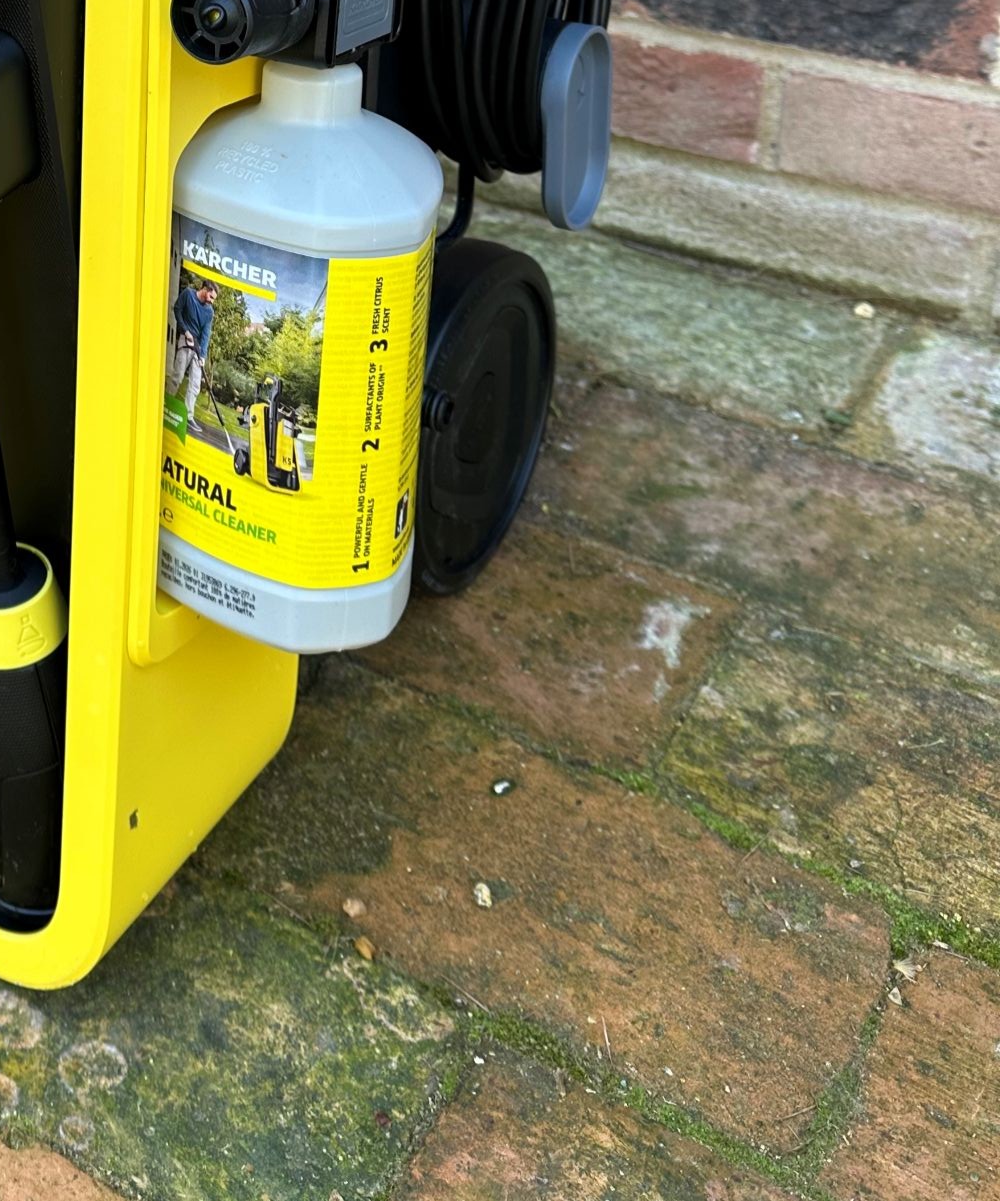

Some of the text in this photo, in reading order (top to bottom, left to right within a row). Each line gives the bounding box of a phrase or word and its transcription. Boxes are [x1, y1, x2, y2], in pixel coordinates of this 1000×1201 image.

[214, 160, 264, 183] PLASTIC
[217, 146, 279, 173] RECYCLED
[183, 239, 277, 288] KÄRCHER
[372, 276, 383, 334] FRESH CITRUS
[382, 307, 390, 334] SCENT
[369, 338, 388, 353] 3
[364, 362, 376, 432] SURFACTANTS OF
[374, 403, 382, 430] PLANT
[361, 438, 379, 452] 2
[162, 455, 237, 512] ATURAL
[161, 477, 277, 545] NIVERSAL CLEANER
[353, 463, 368, 558] POWERFUL AND GENTLE
[364, 498, 374, 557] ON MATERIALS
[351, 560, 370, 573] 1
